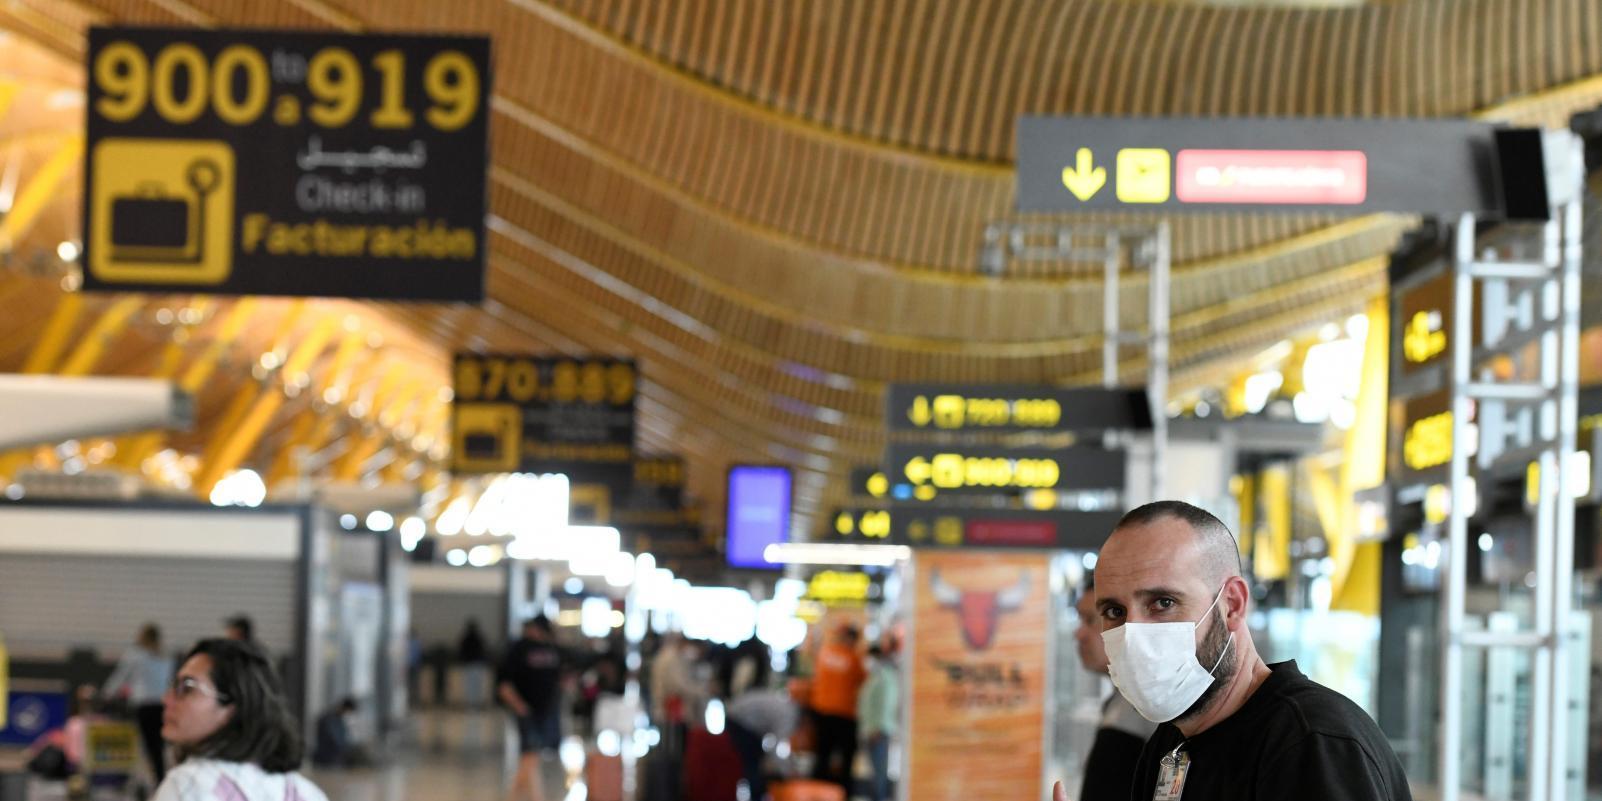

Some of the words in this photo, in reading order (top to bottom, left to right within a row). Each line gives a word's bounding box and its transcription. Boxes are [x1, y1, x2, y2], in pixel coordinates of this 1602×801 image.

[94, 40, 270, 125] 900
[273, 94, 299, 126] a
[307, 46, 480, 132] 919
[242, 212, 474, 259] Facturación
